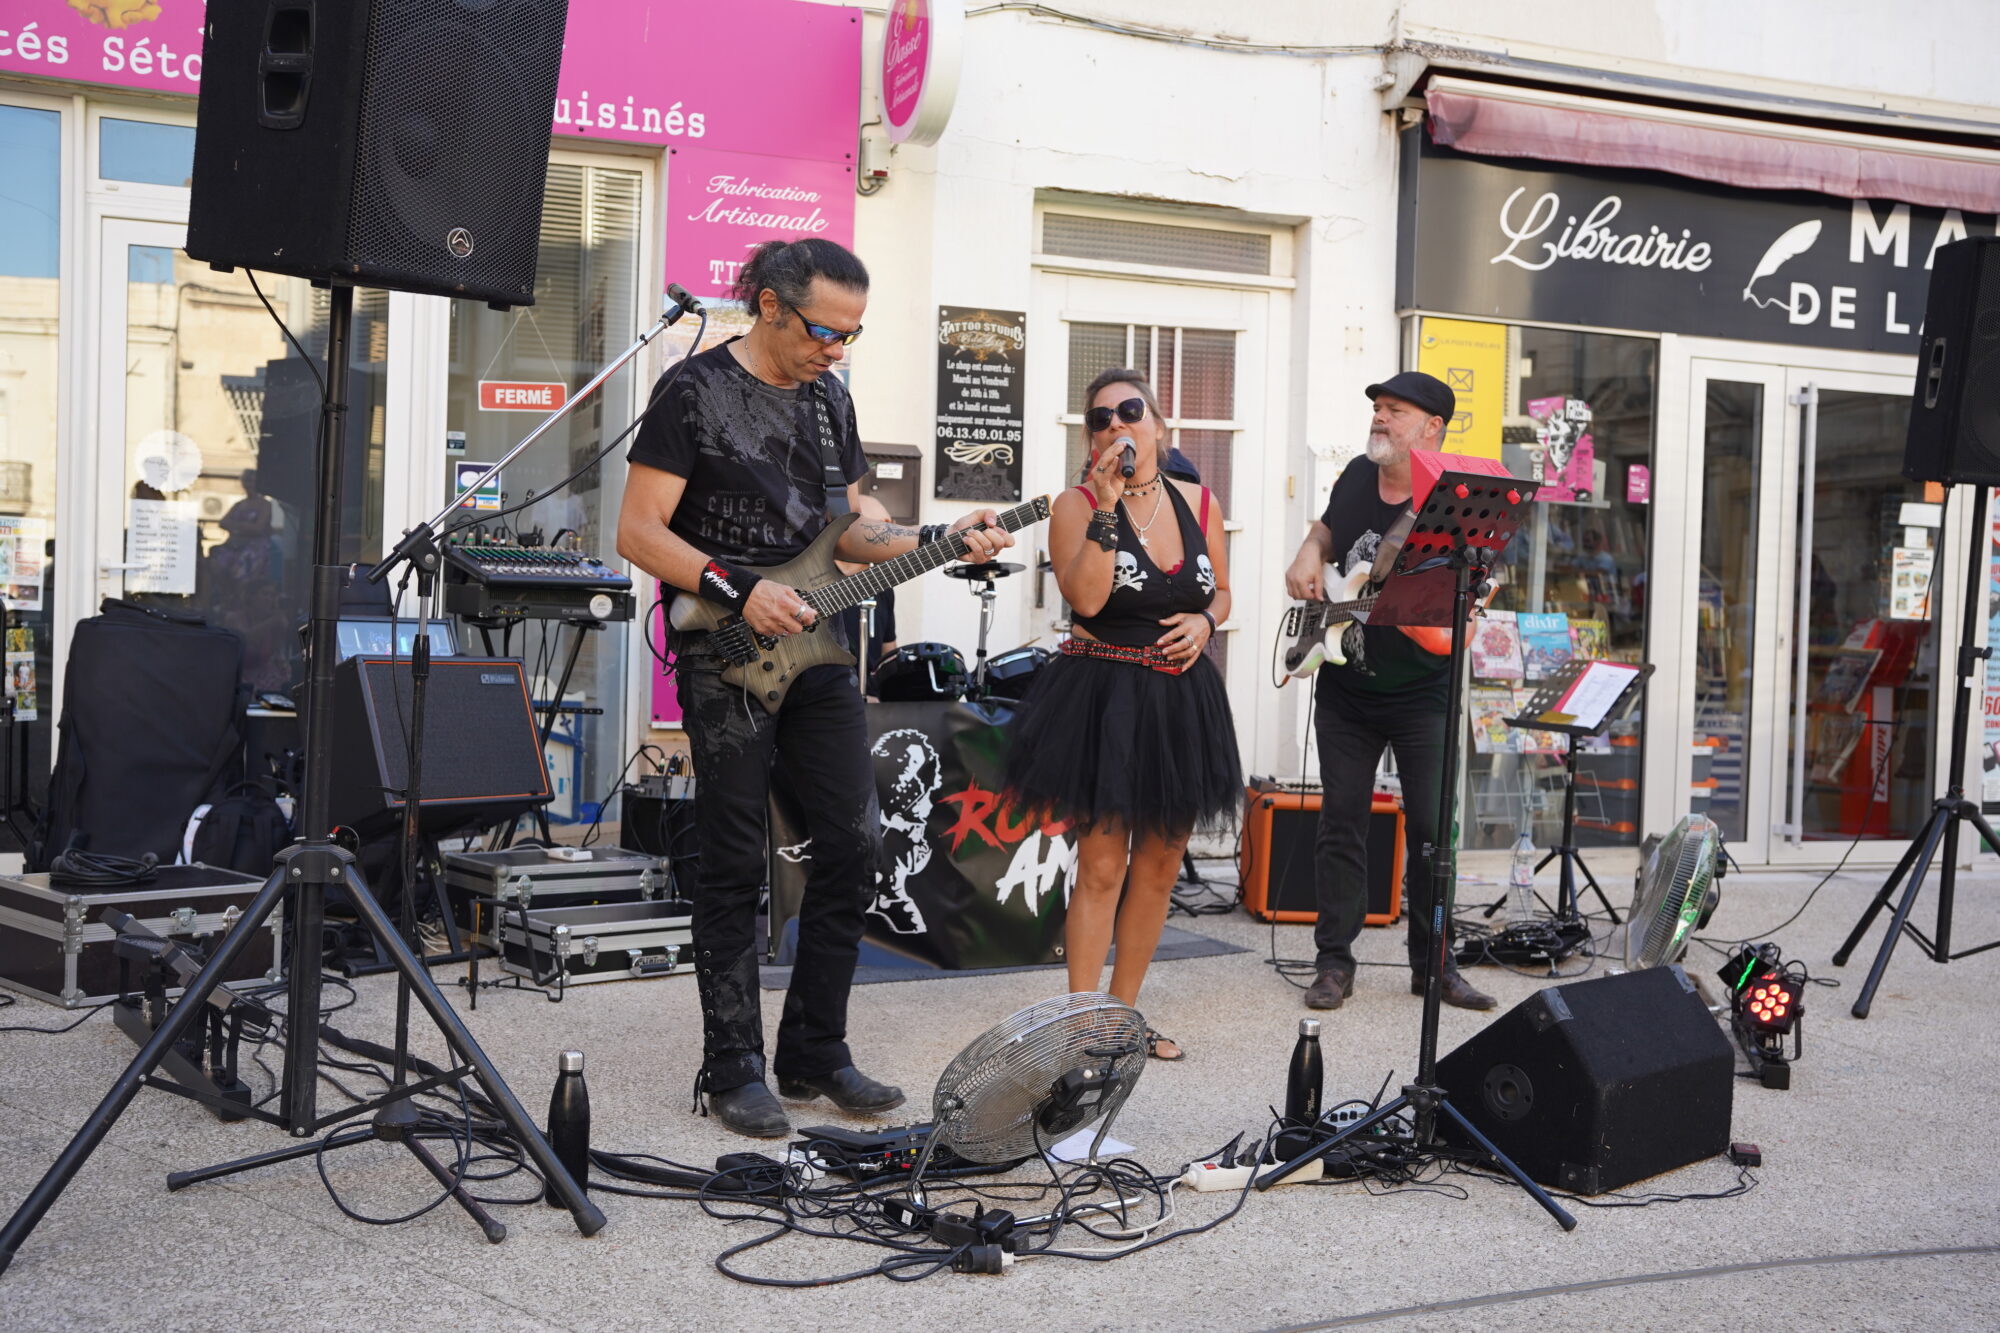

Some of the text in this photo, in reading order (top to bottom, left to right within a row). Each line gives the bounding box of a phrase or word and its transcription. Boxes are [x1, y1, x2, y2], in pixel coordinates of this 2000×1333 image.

[102, 27, 205, 81] Séto
[706, 175, 821, 203] Fabrication
[687, 197, 829, 233] Artisanale
[1490, 186, 1712, 272] Librairie
[1849, 200, 2000, 270] MA
[709, 260, 752, 286] TI
[1789, 282, 1924, 335] DE L
[939, 321, 981, 344] TATTOO
[984, 322, 1024, 350] STUDIO
[946, 359, 956, 370] Le
[956, 360, 971, 373] shop
[972, 363, 982, 371] est
[982, 364, 1002, 373] ouvert
[952, 374, 972, 385] Mardi
[981, 375, 1009, 387] Vendredi
[961, 387, 970, 398] de
[495, 386, 552, 405] FERMÉ
[949, 400, 1011, 414] et le lundi et samedi
[937, 413, 973, 425] uniquement
[974, 417, 984, 425] sur
[937, 426, 1022, 442] 06.13.49.01.95
[707, 495, 766, 518] eyes
[938, 772, 1077, 857] ROC
